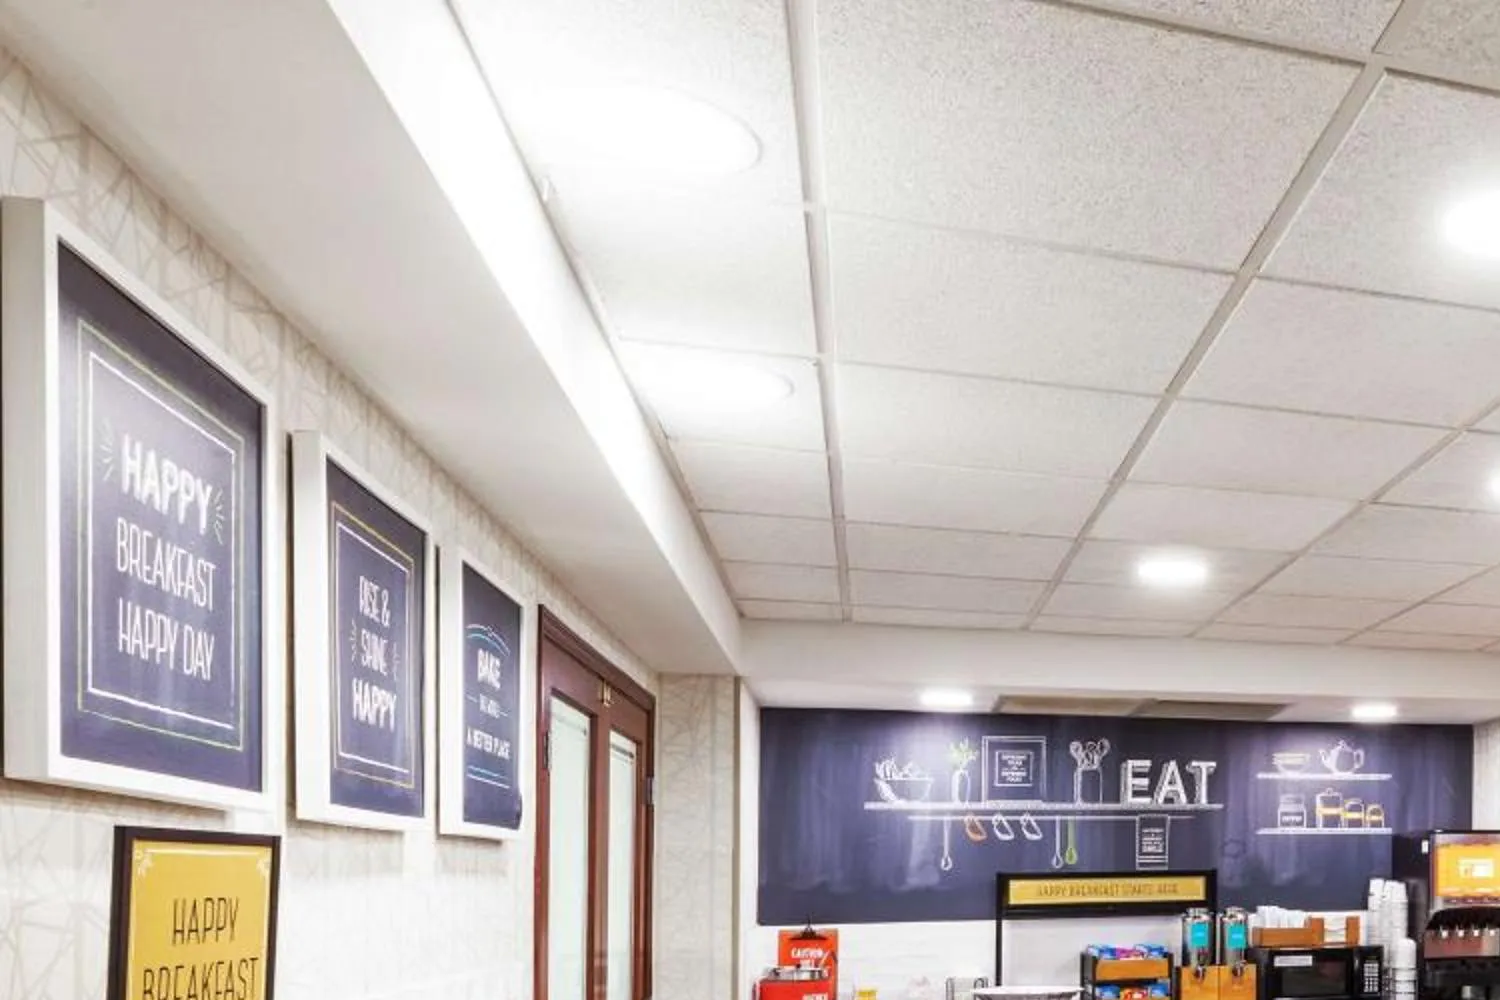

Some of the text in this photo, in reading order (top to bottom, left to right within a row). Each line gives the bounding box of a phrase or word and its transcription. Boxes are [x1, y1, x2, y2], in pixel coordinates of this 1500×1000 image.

[121, 433, 213, 537] HAPPY
[116, 516, 217, 612] BREAKFAST
[117, 597, 215, 681] HAPPY DAY
[351, 677, 398, 733] HAPPY
[1120, 759, 1217, 805] EAT
[172, 896, 240, 947] HAPPY
